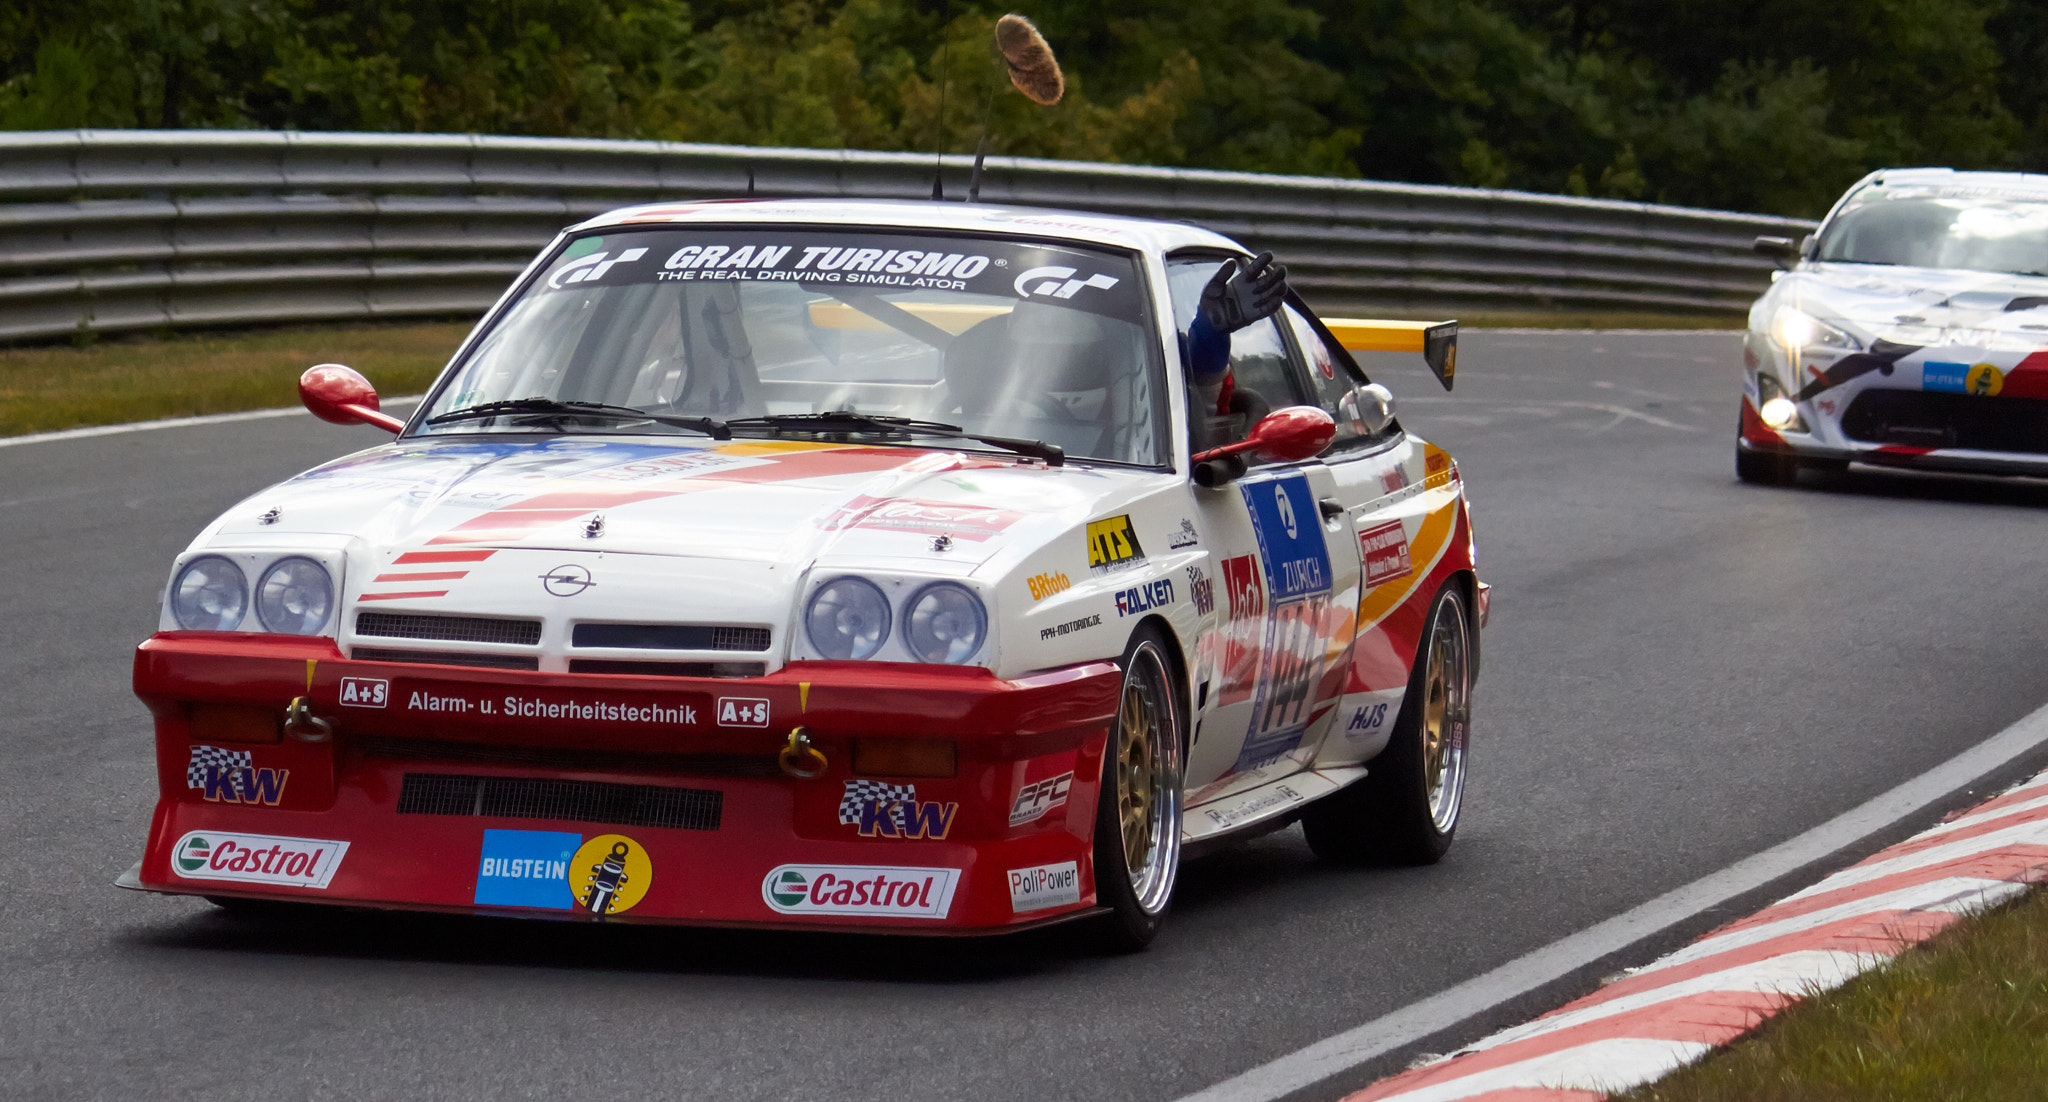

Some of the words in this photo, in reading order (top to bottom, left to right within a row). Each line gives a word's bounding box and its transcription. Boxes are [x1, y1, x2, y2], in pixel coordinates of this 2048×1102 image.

[664, 245, 791, 270] GRAN
[795, 246, 989, 279] TURISMO
[657, 271, 694, 281] THE
[700, 270, 752, 280] REAL
[757, 271, 840, 282] DRIVING
[846, 273, 966, 291] SIMULATOR
[1087, 515, 1133, 566] ATS
[1027, 570, 1071, 601] BRfoto
[1282, 557, 1322, 593] ZURICH
[1115, 578, 1175, 617] FALKEN
[1040, 613, 1102, 641] PPH-MOTORING.DE
[343, 682, 385, 703] A+S
[408, 691, 474, 712] Alarm-
[480, 700, 497, 714] u.
[503, 696, 697, 725] Sicherheitstechnik
[721, 701, 766, 723] A+S
[1348, 703, 1388, 730] HJS
[1452, 722, 1463, 749] BBS
[203, 766, 290, 806] KW
[1013, 773, 1072, 813] PFC
[858, 800, 959, 839] KW
[209, 841, 324, 878] Castrol
[482, 857, 565, 880] BILSTEIN
[810, 873, 934, 908] Castrol
[1011, 869, 1076, 895] PoliPower
